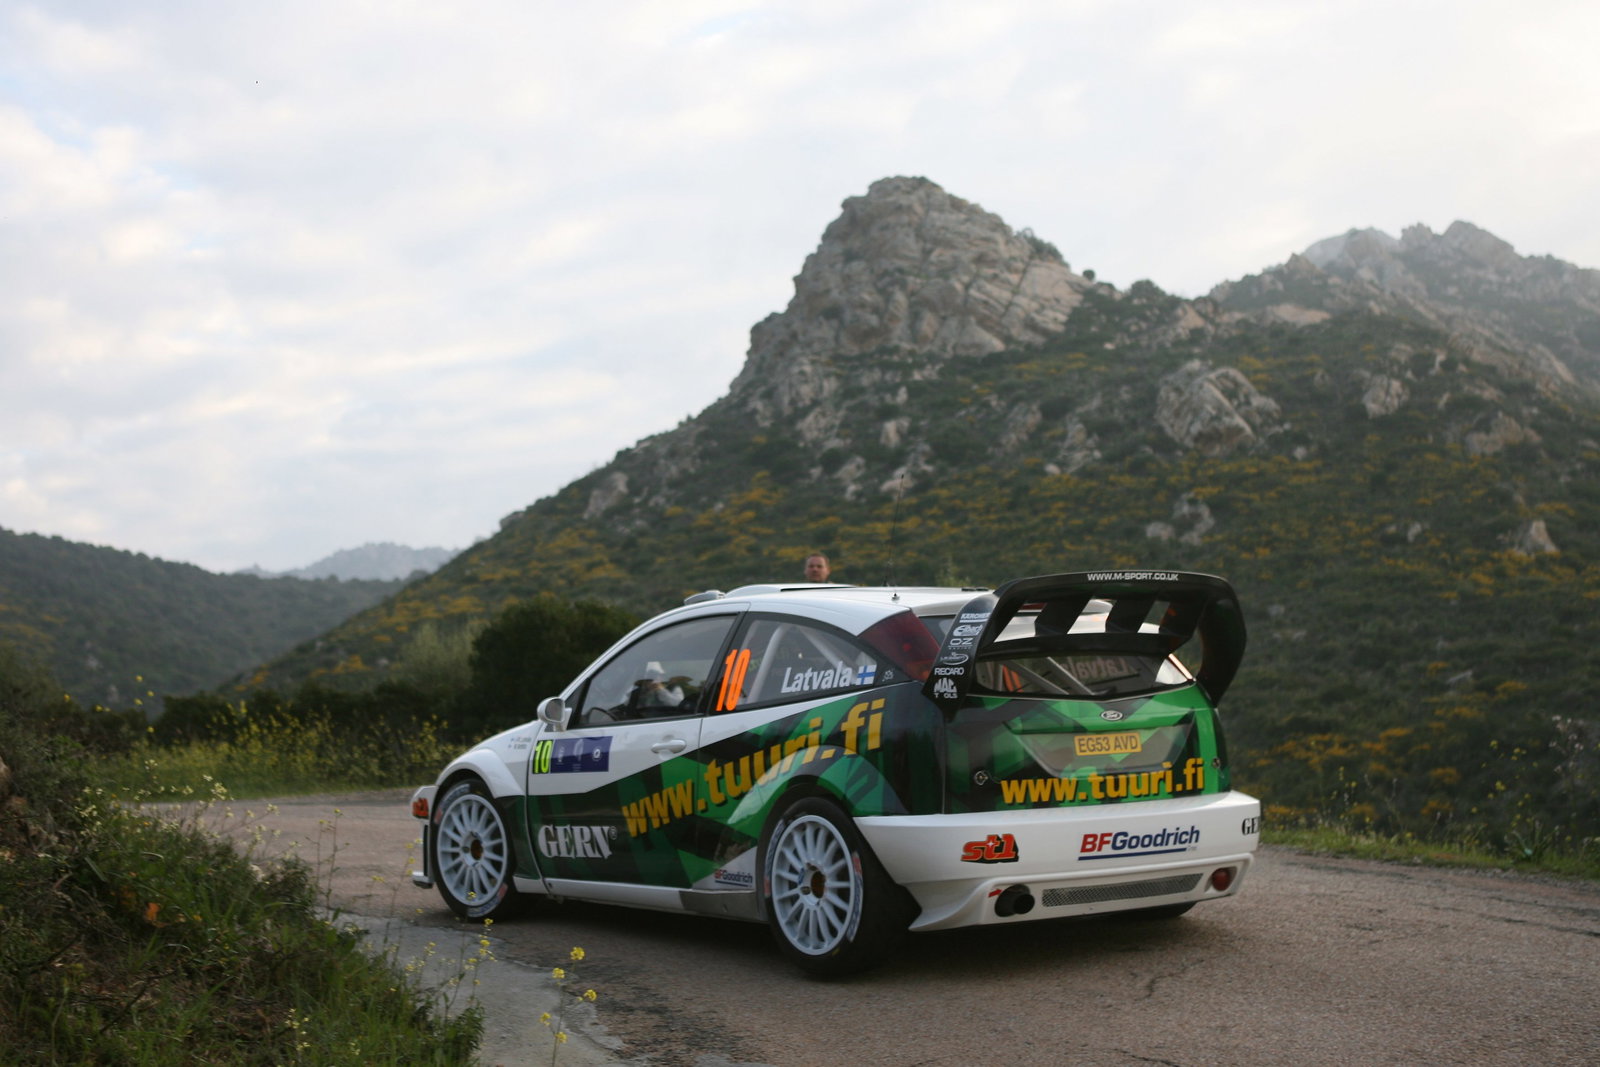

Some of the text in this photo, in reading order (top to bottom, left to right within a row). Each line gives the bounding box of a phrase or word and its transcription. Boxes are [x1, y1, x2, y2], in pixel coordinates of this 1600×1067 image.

[950, 637, 974, 646] OZ
[716, 649, 752, 712] 10
[780, 660, 854, 694] Latvala
[934, 667, 965, 676] RECARO
[1077, 732, 1139, 753] EG53 AVD
[533, 740, 553, 774] 10
[622, 698, 886, 838] www.tuuri.fi
[1001, 757, 1205, 804] www.tuuri.fi
[1080, 825, 1200, 853] BFGoodrich
[1241, 816, 1261, 836] GE
[714, 868, 753, 884] BFGoodrich
